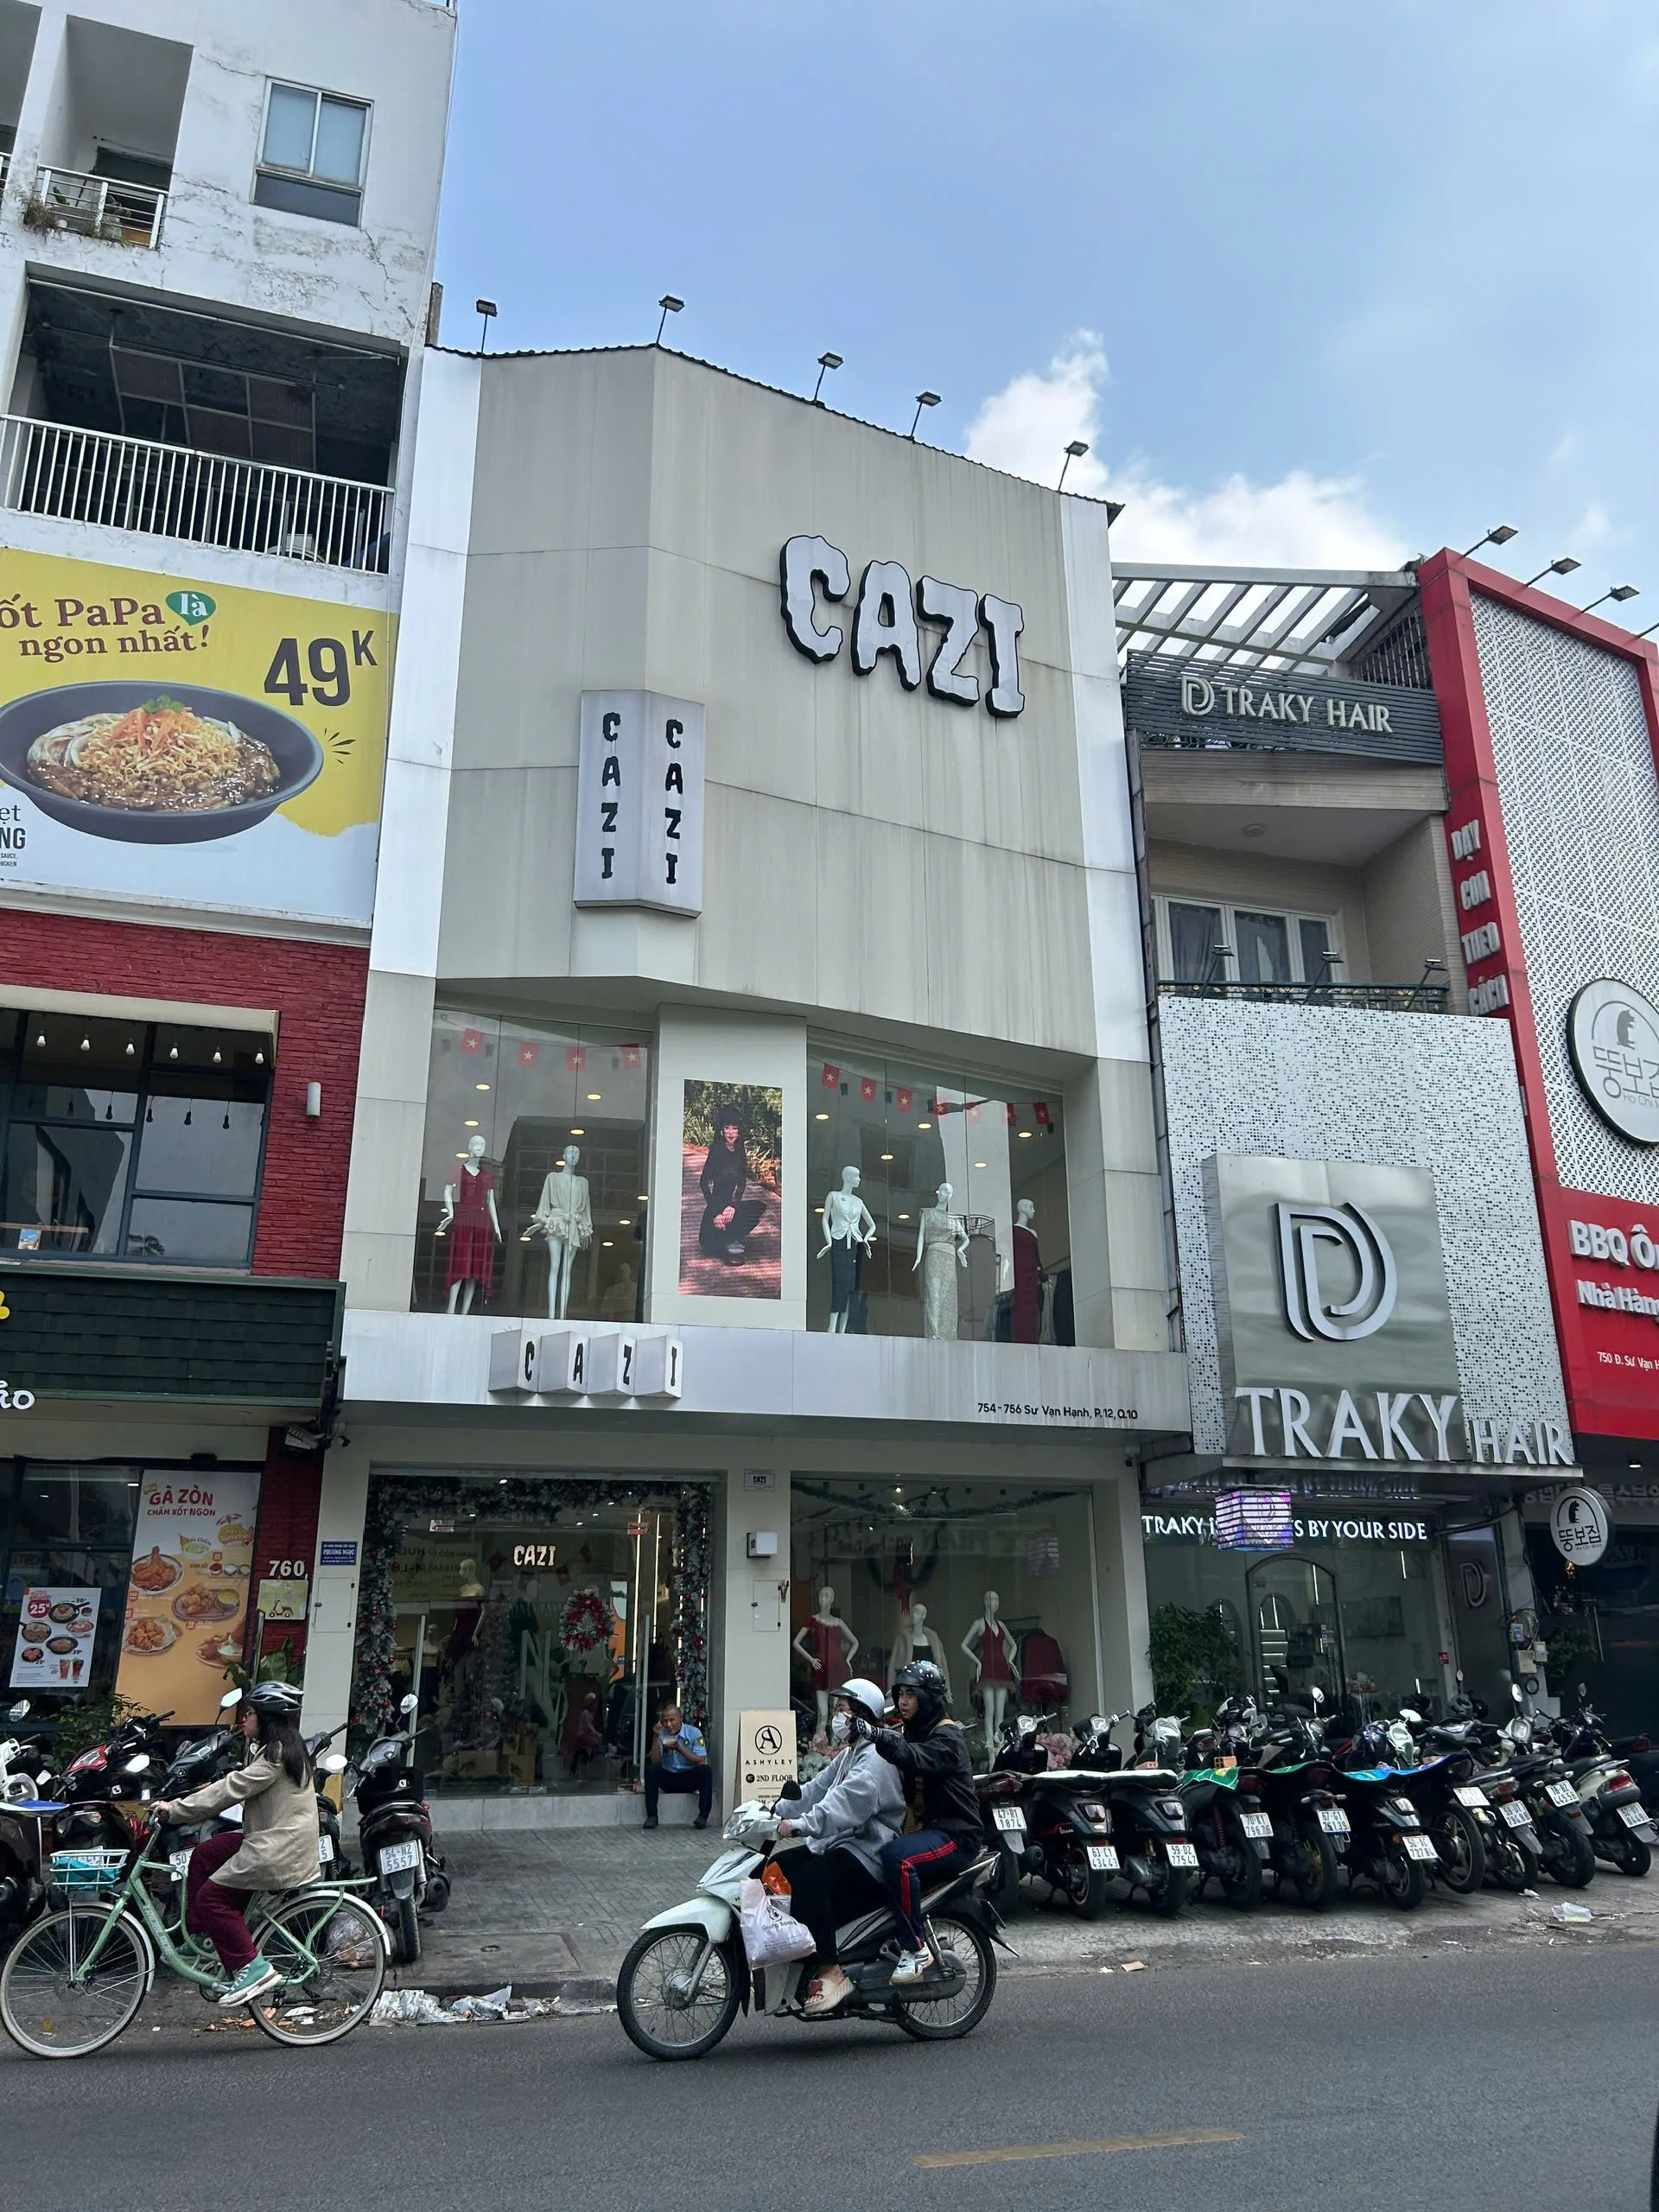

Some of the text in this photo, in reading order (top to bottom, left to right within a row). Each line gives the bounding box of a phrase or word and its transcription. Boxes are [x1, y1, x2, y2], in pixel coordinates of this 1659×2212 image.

[54, 597, 165, 627] PaPa
[179, 593, 208, 617] là
[779, 535, 1025, 718] CAZI
[19, 635, 107, 664] ngon
[1220, 685, 1314, 723] TRAKY
[1326, 698, 1393, 733] HAIR
[601, 712, 621, 880] CAZI
[664, 718, 684, 885] CAZI
[1567, 1219, 1630, 1268] BBQ
[1576, 1279, 1615, 1310] Nhà
[524, 1340, 677, 1387] CAZI
[1598, 1351, 1612, 1364] 750
[1042, 1406, 1061, 1418] Vạn
[1233, 1387, 1573, 1466] TRAKY HAIR
[149, 1484, 174, 1505] GÀ
[177, 1484, 213, 1505] ZÒN
[189, 1507, 216, 1516] NGON
[1141, 1515, 1205, 1536] TRAKY
[1308, 1520, 1329, 1538] BY
[1332, 1521, 1384, 1540] YOUR
[1389, 1522, 1427, 1540] SIDE
[269, 1560, 305, 1577] 760
[513, 1544, 556, 1567] CAZI
[386, 1855, 413, 1872] 5557
